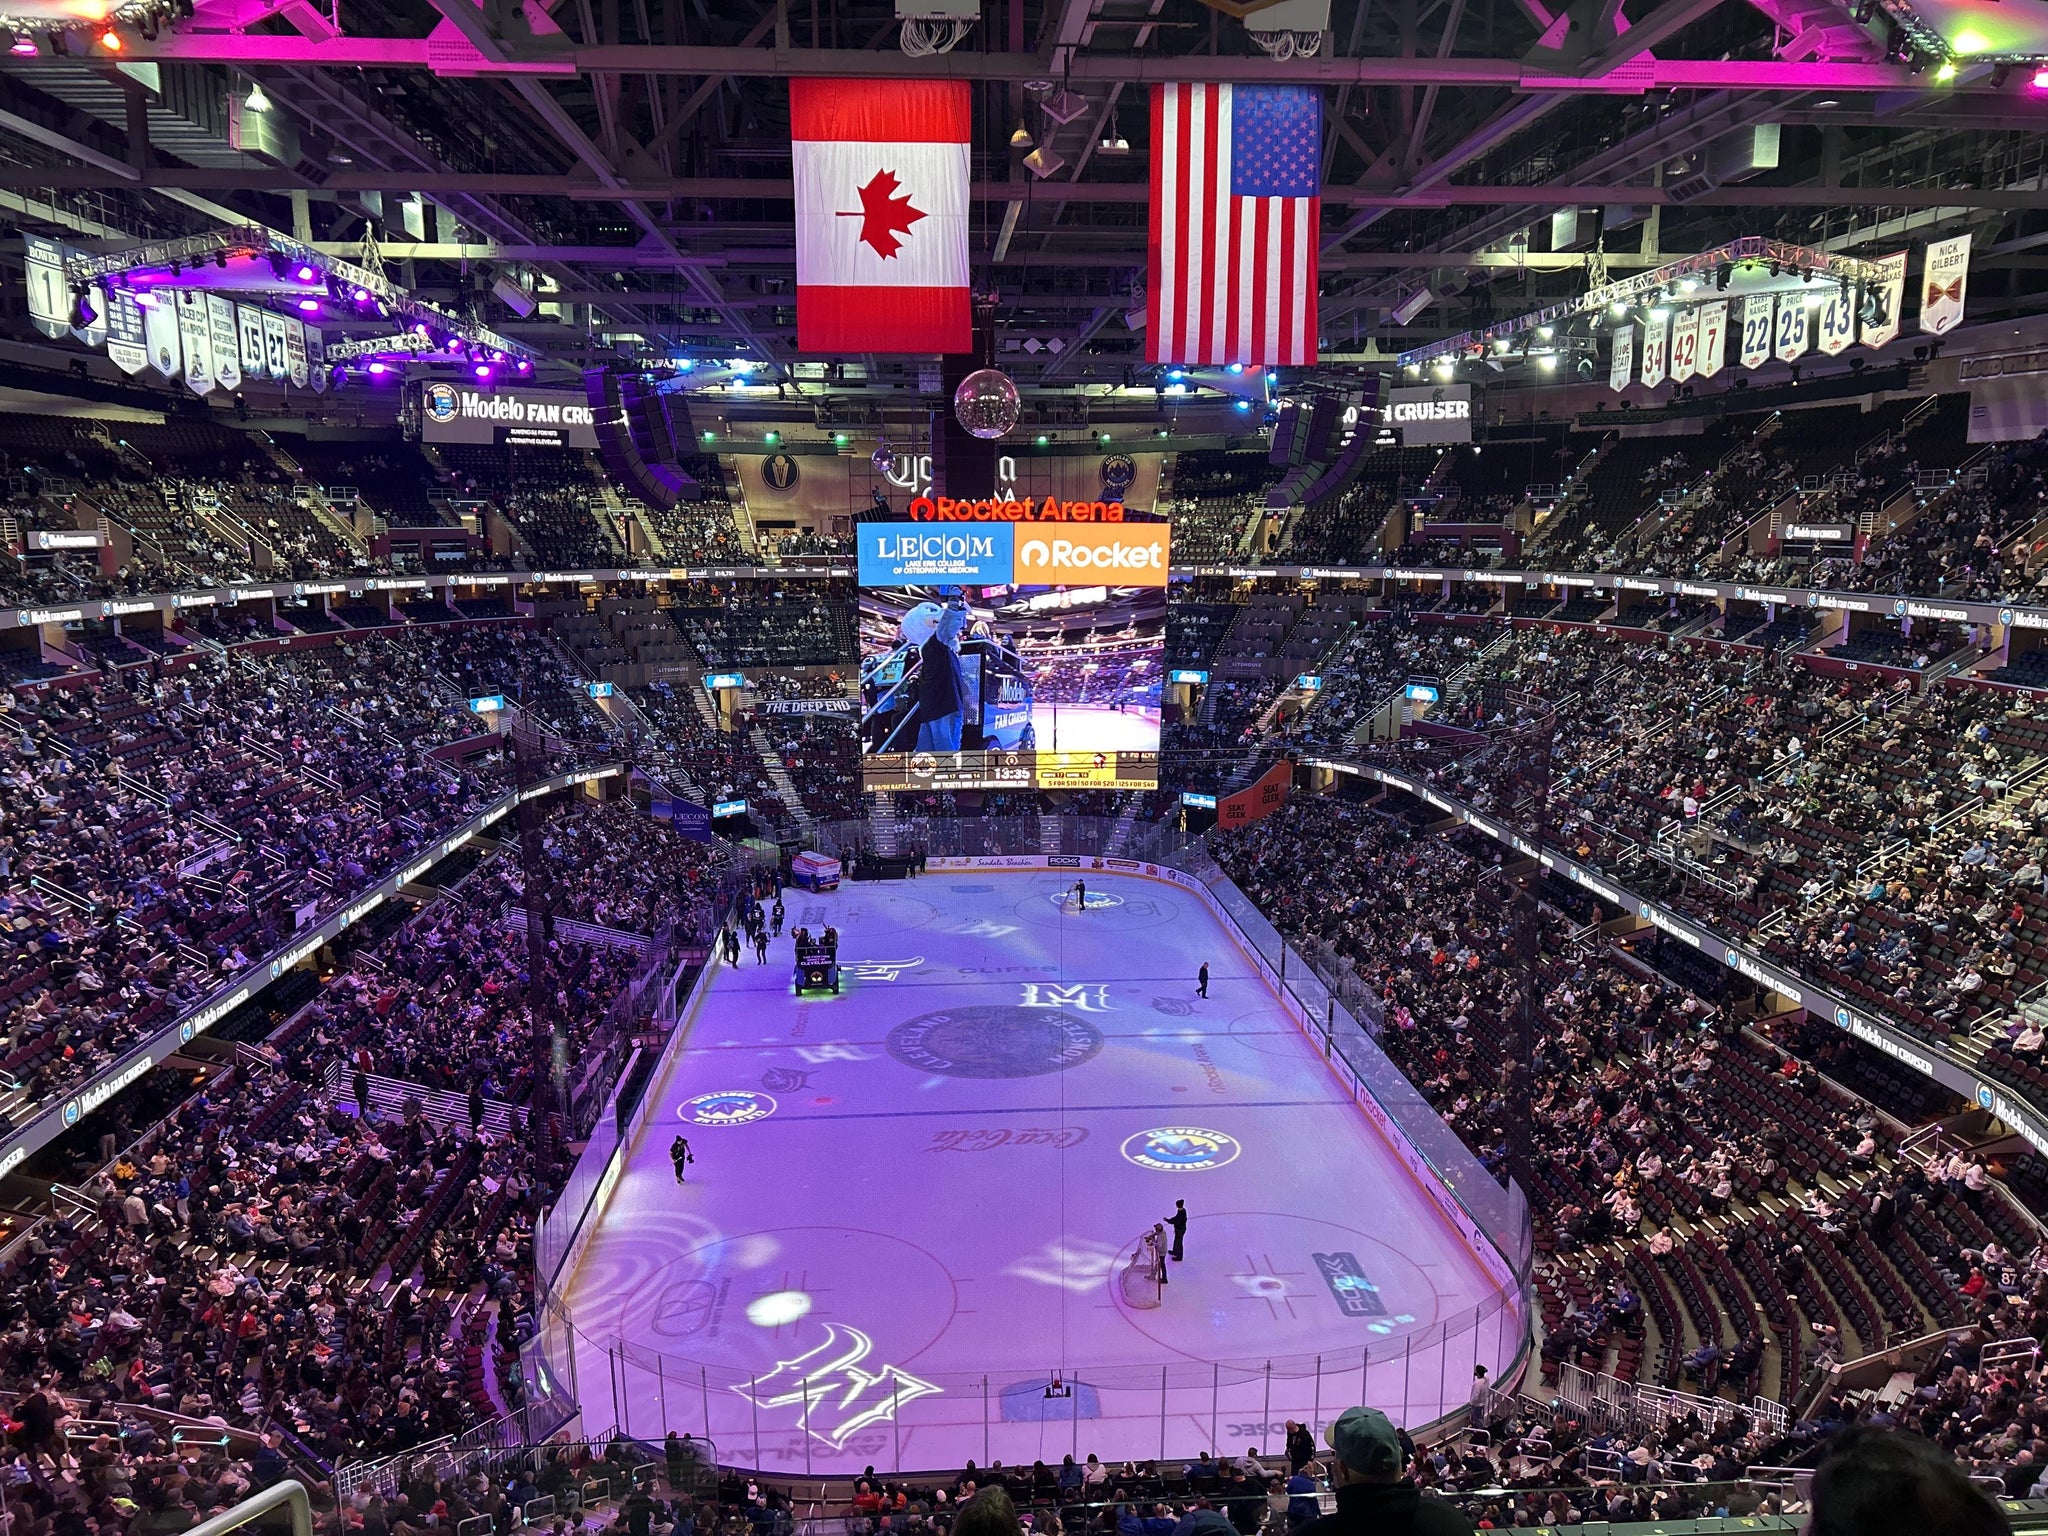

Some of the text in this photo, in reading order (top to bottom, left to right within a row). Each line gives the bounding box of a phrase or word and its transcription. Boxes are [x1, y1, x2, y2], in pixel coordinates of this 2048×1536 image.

[28, 246, 60, 264] BOWER
[1939, 243, 1959, 257] NICK
[1931, 253, 1965, 270] GILBERT
[42, 271, 53, 315] 1
[1749, 304, 1769, 316] NANCE
[1823, 298, 1850, 338] 43
[1745, 316, 1769, 354] 22
[1779, 308, 1805, 348] 25
[244, 326, 261, 362] 15
[268, 334, 285, 368] 27
[1674, 334, 1695, 367] 42
[1707, 328, 1717, 361] 7
[1645, 341, 1663, 374] 34
[461, 392, 524, 420] Modelo
[526, 404, 560, 423] FAN
[1394, 401, 1470, 421] CRUISER
[938, 496, 1124, 522] Rocket Arena
[937, 560, 966, 568] COLLEGE
[1051, 539, 1162, 569] Rocket
[1818, 595, 1837, 608] Modelo
[1908, 602, 1968, 621] Modelo FAN CRUISER
[2015, 611, 2042, 627] Modelo
[1002, 678, 1027, 701] Modelo
[766, 701, 851, 713] THE DEEP END
[994, 710, 1028, 730] FAN CRUISER
[952, 752, 963, 770] 1
[994, 767, 1031, 779] 13:35
[1262, 793, 1280, 804] GEEK
[1263, 783, 1280, 794] SEAT
[1226, 811, 1246, 819] GEEK
[1227, 804, 1246, 812] SEAT
[1650, 909, 1669, 931] Modelo
[280, 950, 298, 972] Modelo
[959, 966, 1057, 974] CLIFFS
[1739, 955, 1802, 1003] Modelo FAN CRUISER
[194, 988, 249, 1034] Modelo FAN CRUISER
[900, 1015, 953, 1069] CLEVELAND
[1038, 1015, 1093, 1065] MONSTERS
[1852, 1016, 1934, 1076] Modelo FAN CRUISER
[82, 1056, 152, 1113] Modelo FAN CRUISER
[693, 1110, 767, 1124] CLEVELAND
[1365, 1094, 1387, 1130] Rocket
[1995, 1096, 2039, 1146] Modelo FAN
[922, 1126, 1090, 1153] Coca-Cola
[1146, 1129, 1230, 1144] CLEVELAND
[1133, 1154, 1216, 1169] MONSTERS
[1410, 1156, 1419, 1174] nrg
